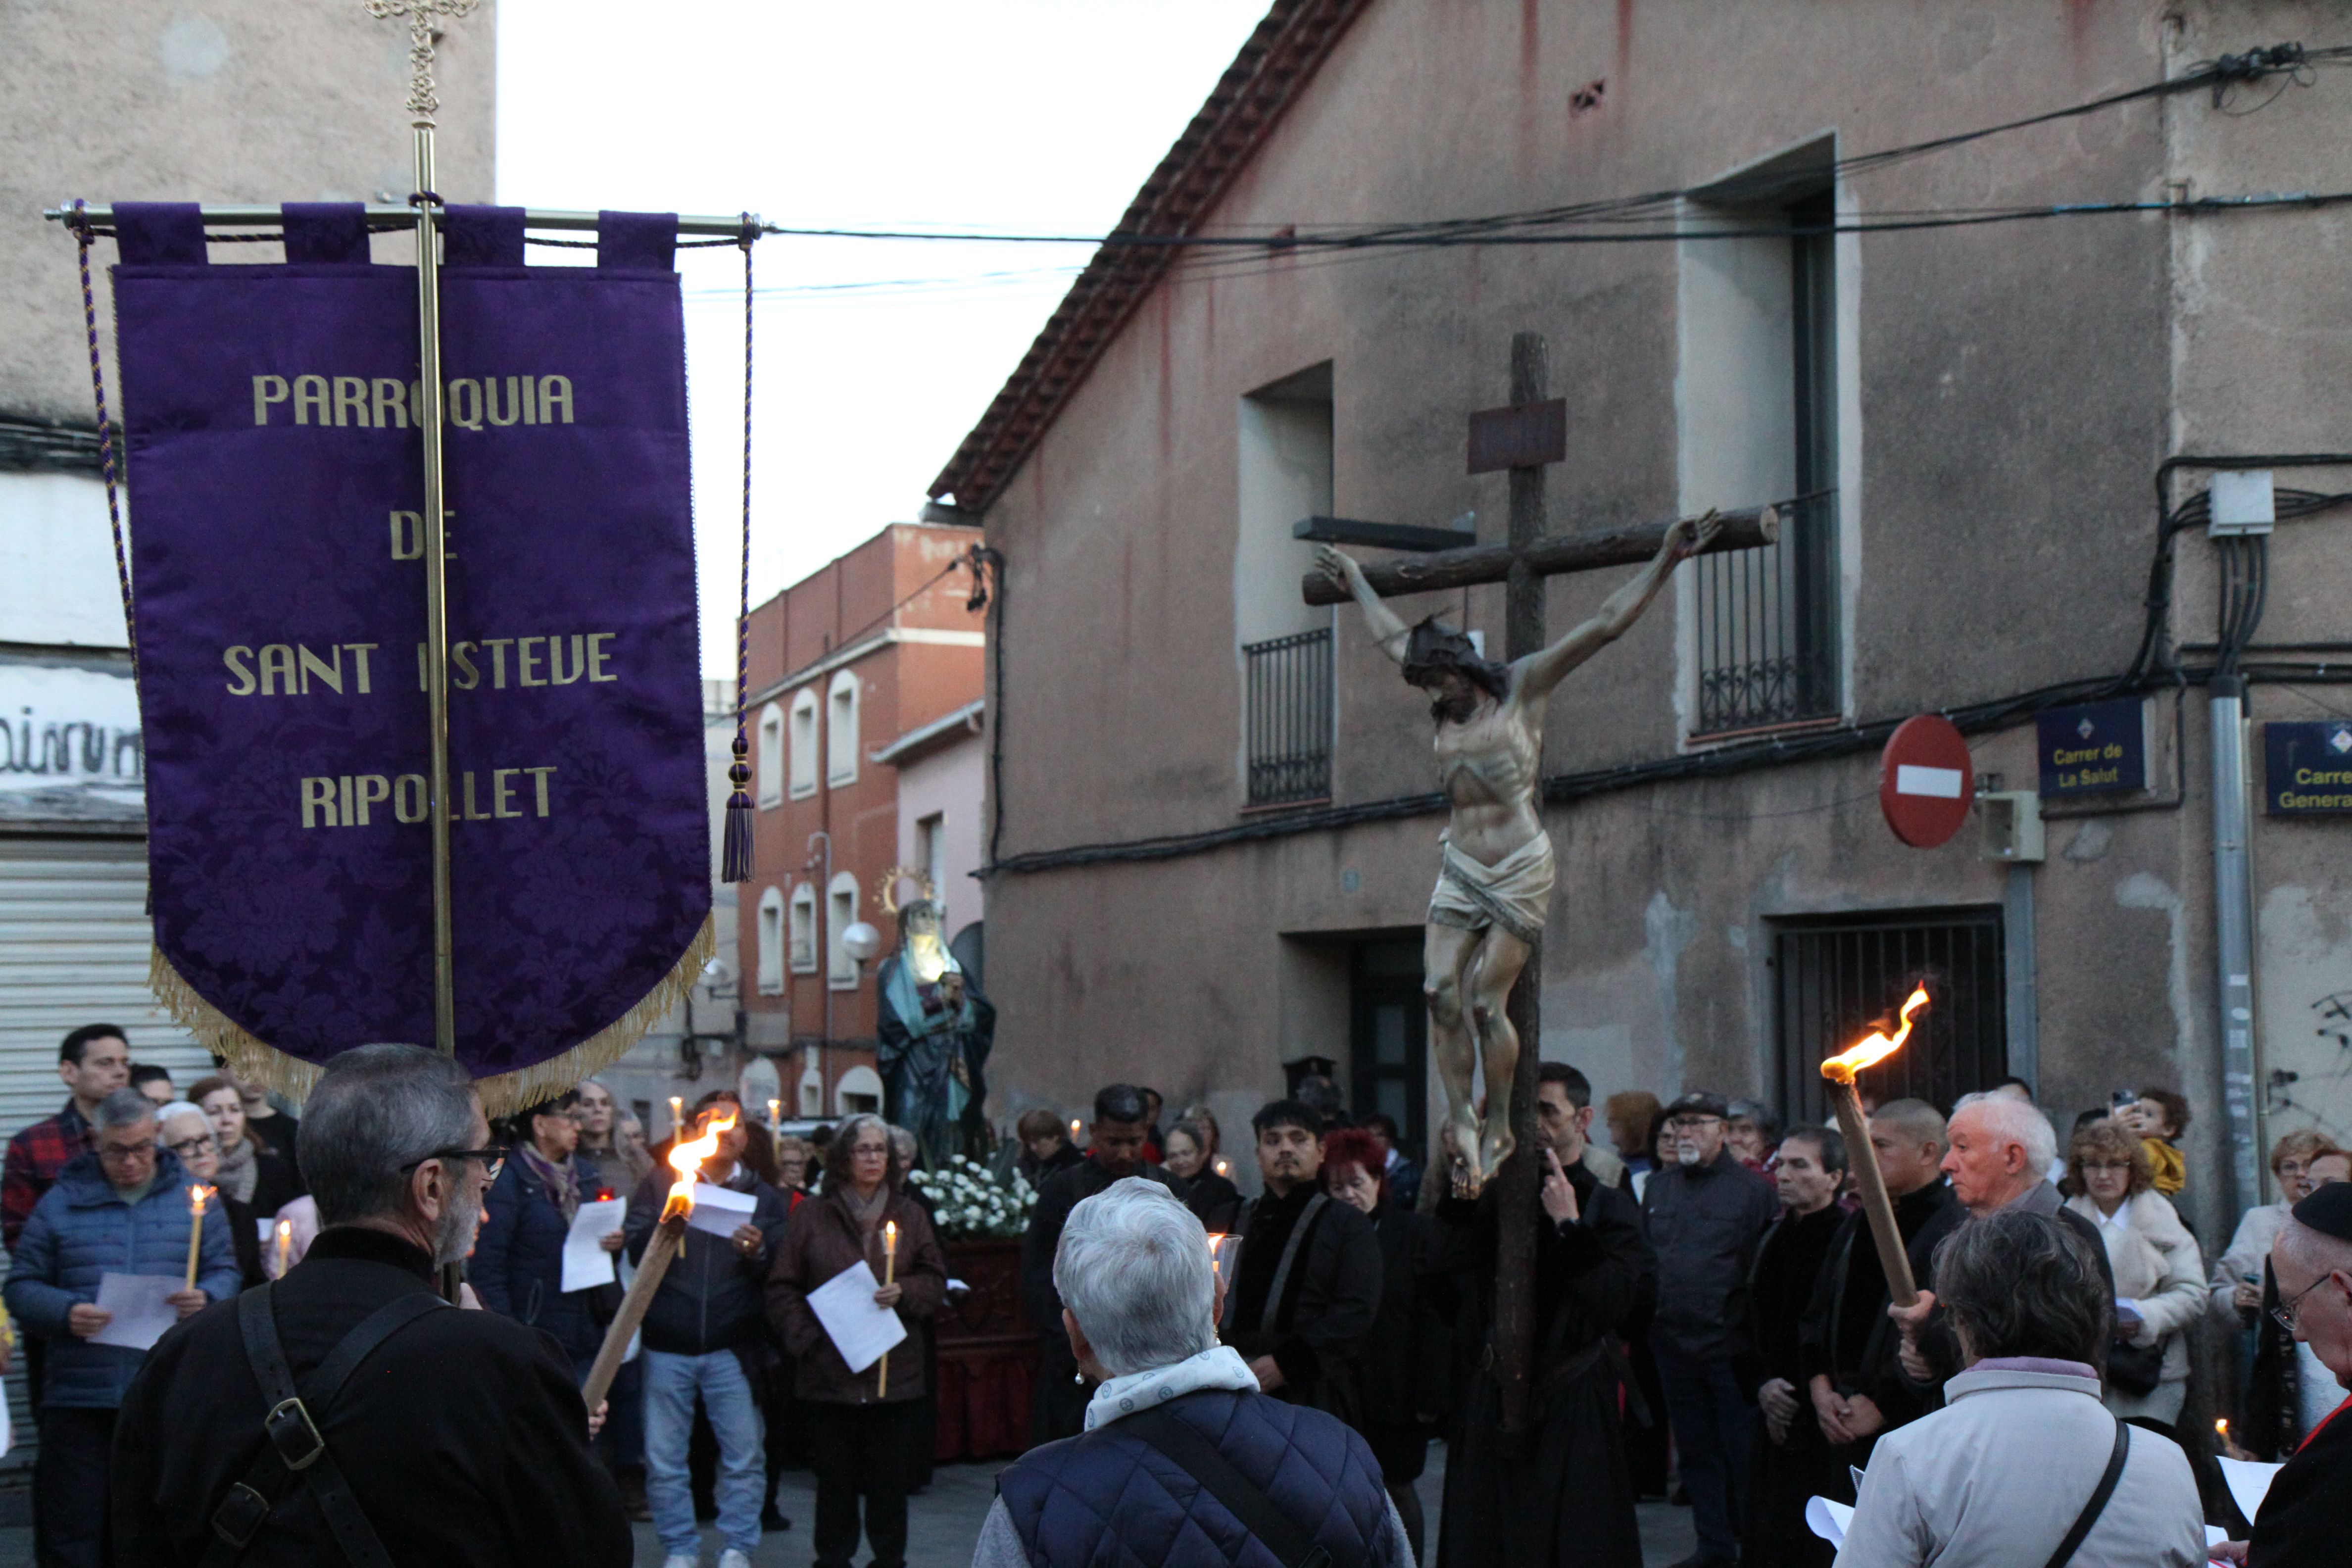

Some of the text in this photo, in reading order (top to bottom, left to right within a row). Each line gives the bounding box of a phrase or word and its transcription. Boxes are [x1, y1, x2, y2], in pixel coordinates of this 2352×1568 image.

[223, 643, 378, 696] SANT
[2054, 743, 2123, 766] Carrer de
[2059, 767, 2118, 788] La Salut
[301, 766, 558, 828] RIPOLET
